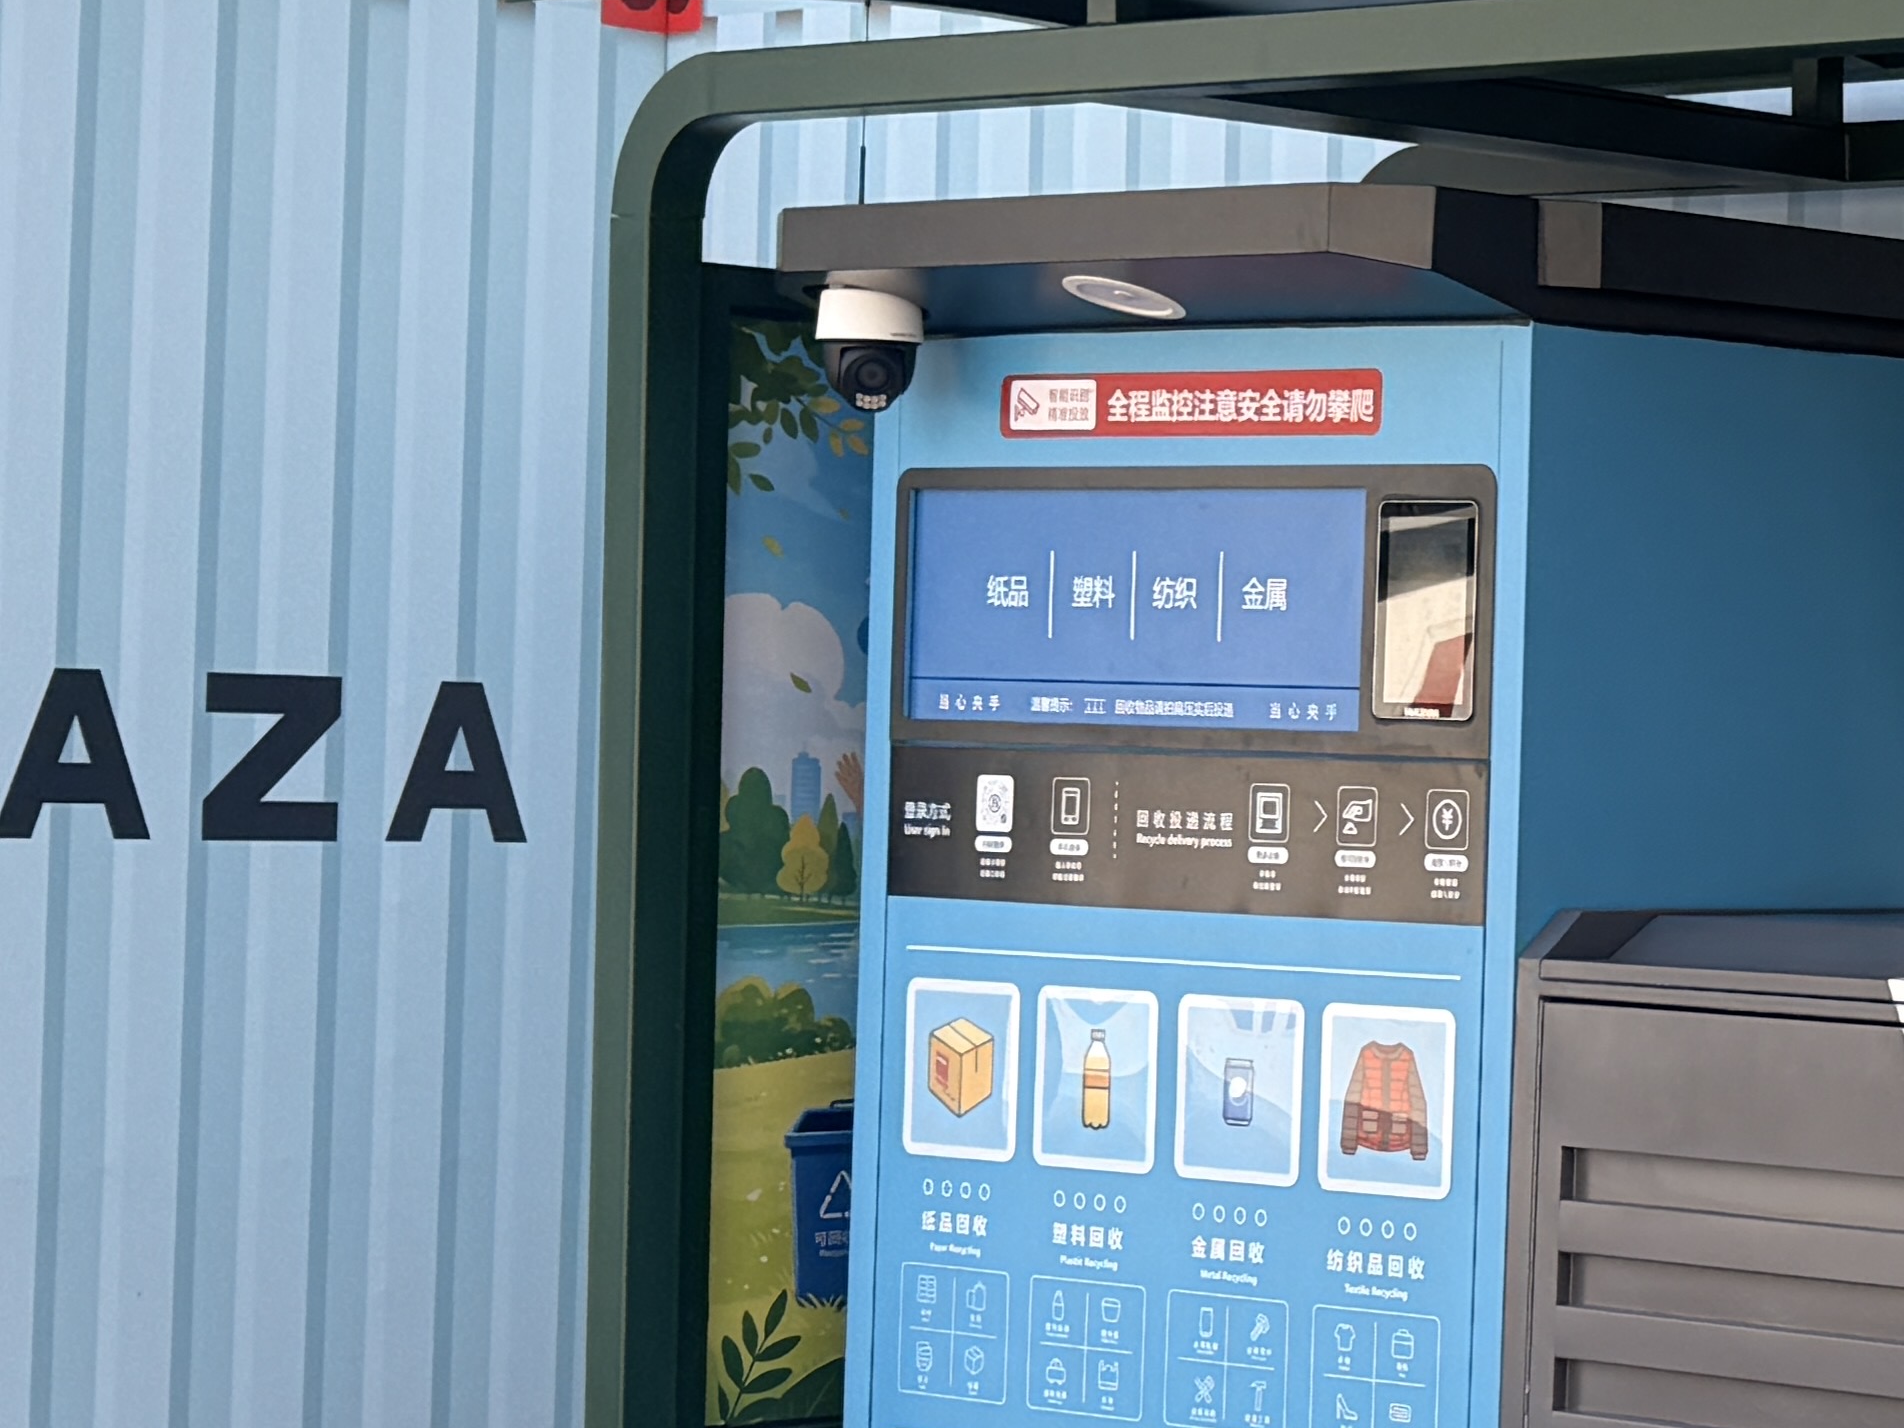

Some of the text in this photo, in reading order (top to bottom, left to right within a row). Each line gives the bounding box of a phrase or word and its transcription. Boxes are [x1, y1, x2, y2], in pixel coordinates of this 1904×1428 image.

[1107, 388, 1374, 423] 全程监控注意安全请勿攀爬
[987, 575, 1029, 609] 纸品
[1071, 575, 1115, 609] 塑料
[1152, 577, 1197, 610] 纺织
[1241, 577, 1288, 611] 金属
[0, 668, 527, 843] AZA
[1136, 810, 1234, 832] 回收投递流程
[1136, 833, 1233, 850] Recycle delivery process
[922, 1210, 987, 1237] 纸品回收
[1052, 1222, 1123, 1251] 塑料回收
[1191, 1235, 1265, 1264] 金属回收
[1327, 1248, 1425, 1280] 纺织品回收
